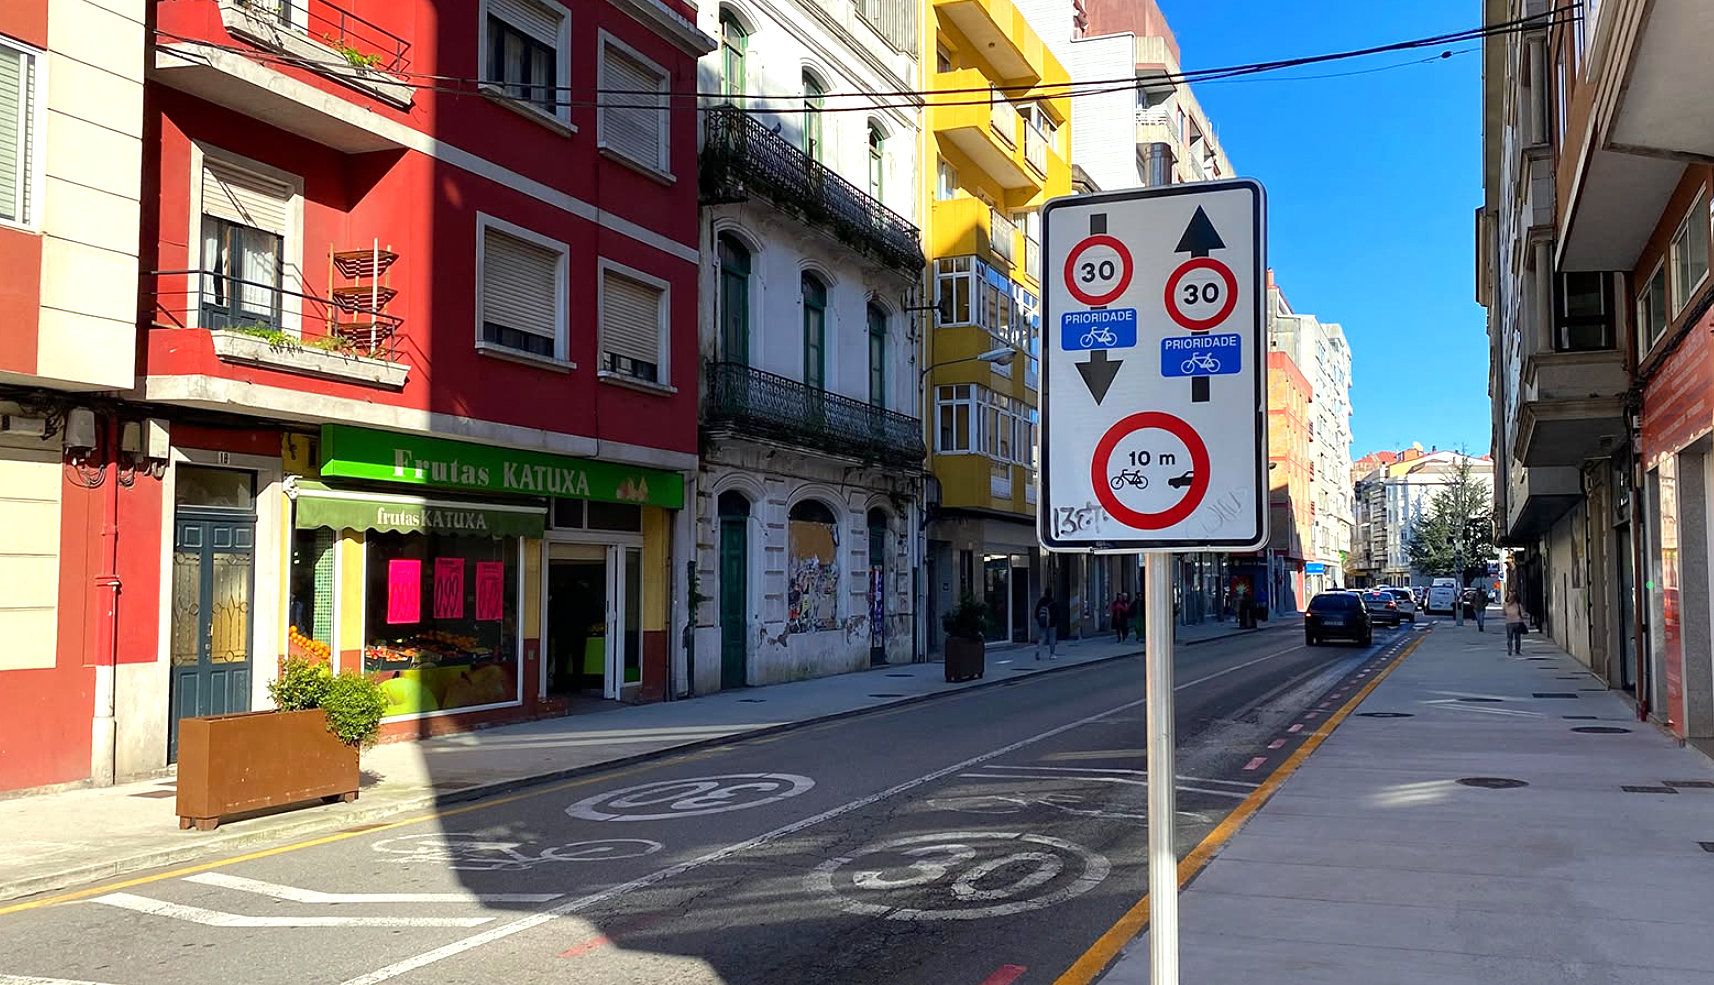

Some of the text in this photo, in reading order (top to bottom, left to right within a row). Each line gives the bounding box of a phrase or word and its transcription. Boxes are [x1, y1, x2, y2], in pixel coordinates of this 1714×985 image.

[1081, 260, 1115, 283] 30
[1183, 282, 1219, 305] 30
[1065, 311, 1133, 324] PRIORIDADE
[1165, 335, 1237, 349] PRIORIDADE
[1128, 450, 1176, 466] 10 m
[392, 448, 590, 496] Frutas KATUXA
[852, 843, 1065, 902] 30
